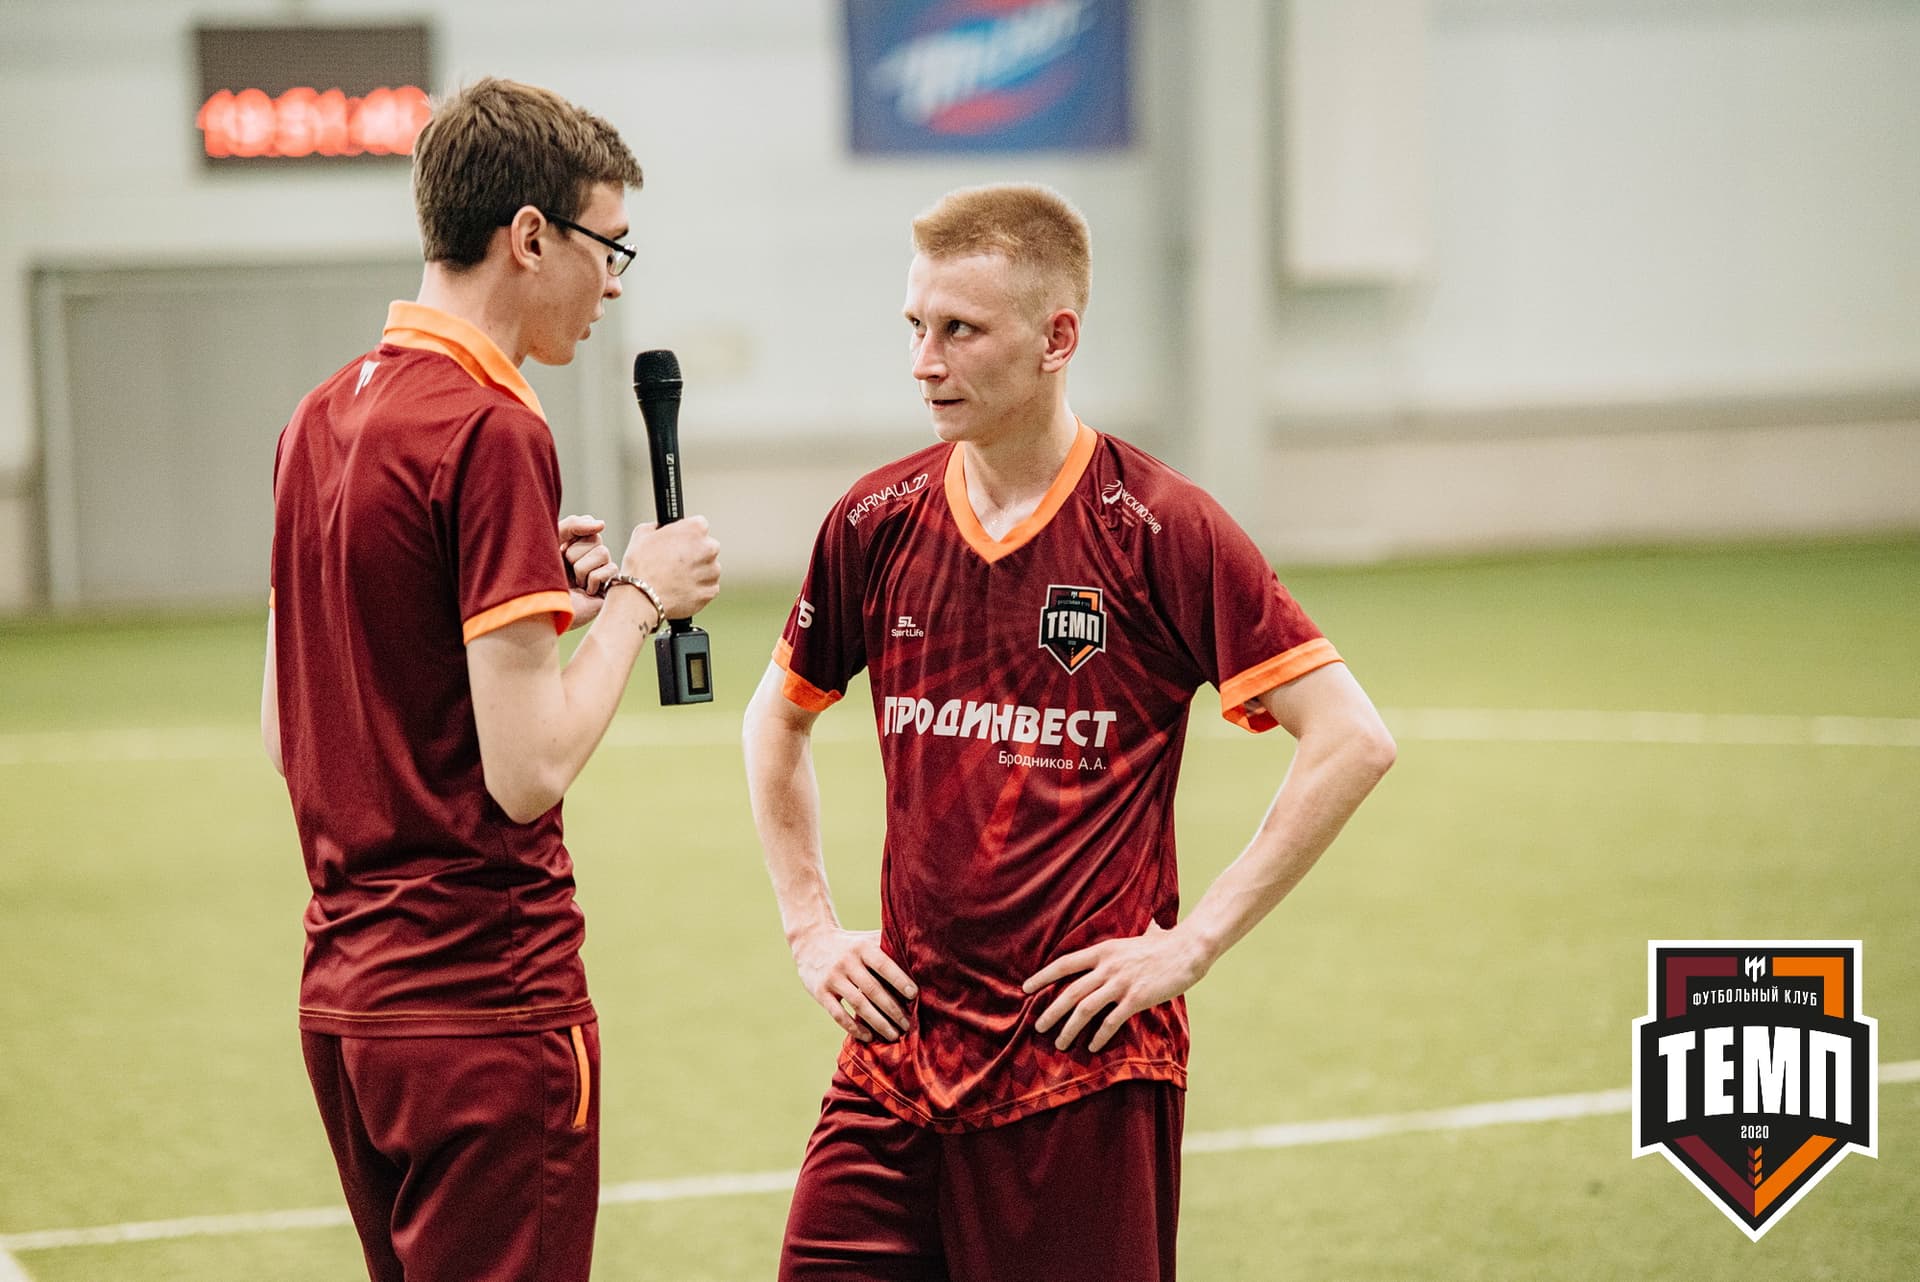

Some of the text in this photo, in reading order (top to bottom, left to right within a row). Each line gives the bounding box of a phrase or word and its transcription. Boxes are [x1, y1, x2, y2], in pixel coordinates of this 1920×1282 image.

[897, 616, 916, 628] SL
[1047, 610, 1100, 643] ТЕМП
[891, 629, 924, 638] SportLife
[884, 696, 1117, 748] ПРОДИНВЕСТ
[998, 750, 1107, 771] Бродников А.А.
